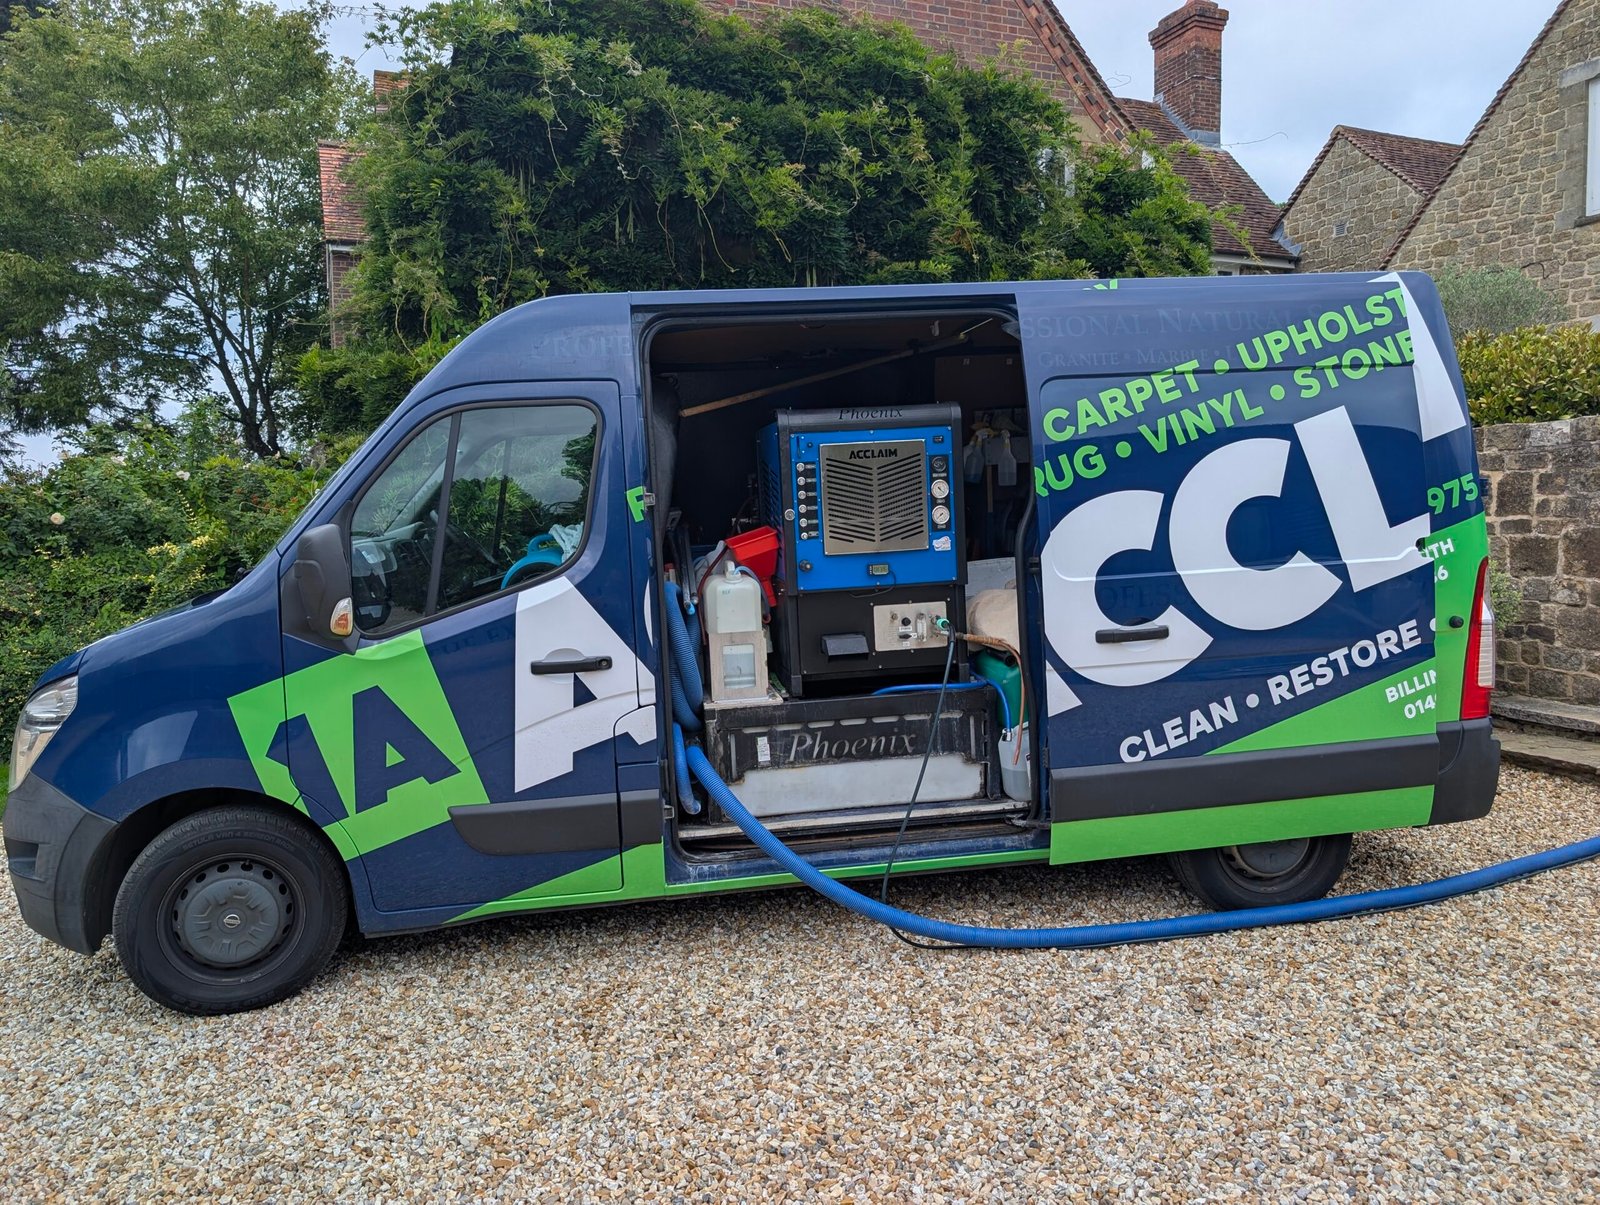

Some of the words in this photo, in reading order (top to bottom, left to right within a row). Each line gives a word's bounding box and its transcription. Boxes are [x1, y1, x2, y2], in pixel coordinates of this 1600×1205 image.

[838, 408, 902, 420] Phoenix
[1043, 359, 1200, 442] CARPET
[1236, 287, 1407, 371] UPHOLST
[1138, 388, 1264, 453] VINYL
[1293, 329, 1415, 399] STONE
[848, 448, 898, 460] ACCLAIM
[1427, 473, 1479, 515] 975
[515, 576, 657, 793] A
[789, 728, 916, 762] Phoenix
[1119, 696, 1238, 763] CLEAN
[1267, 620, 1422, 705] RESTORE
[265, 685, 462, 828] 1A
